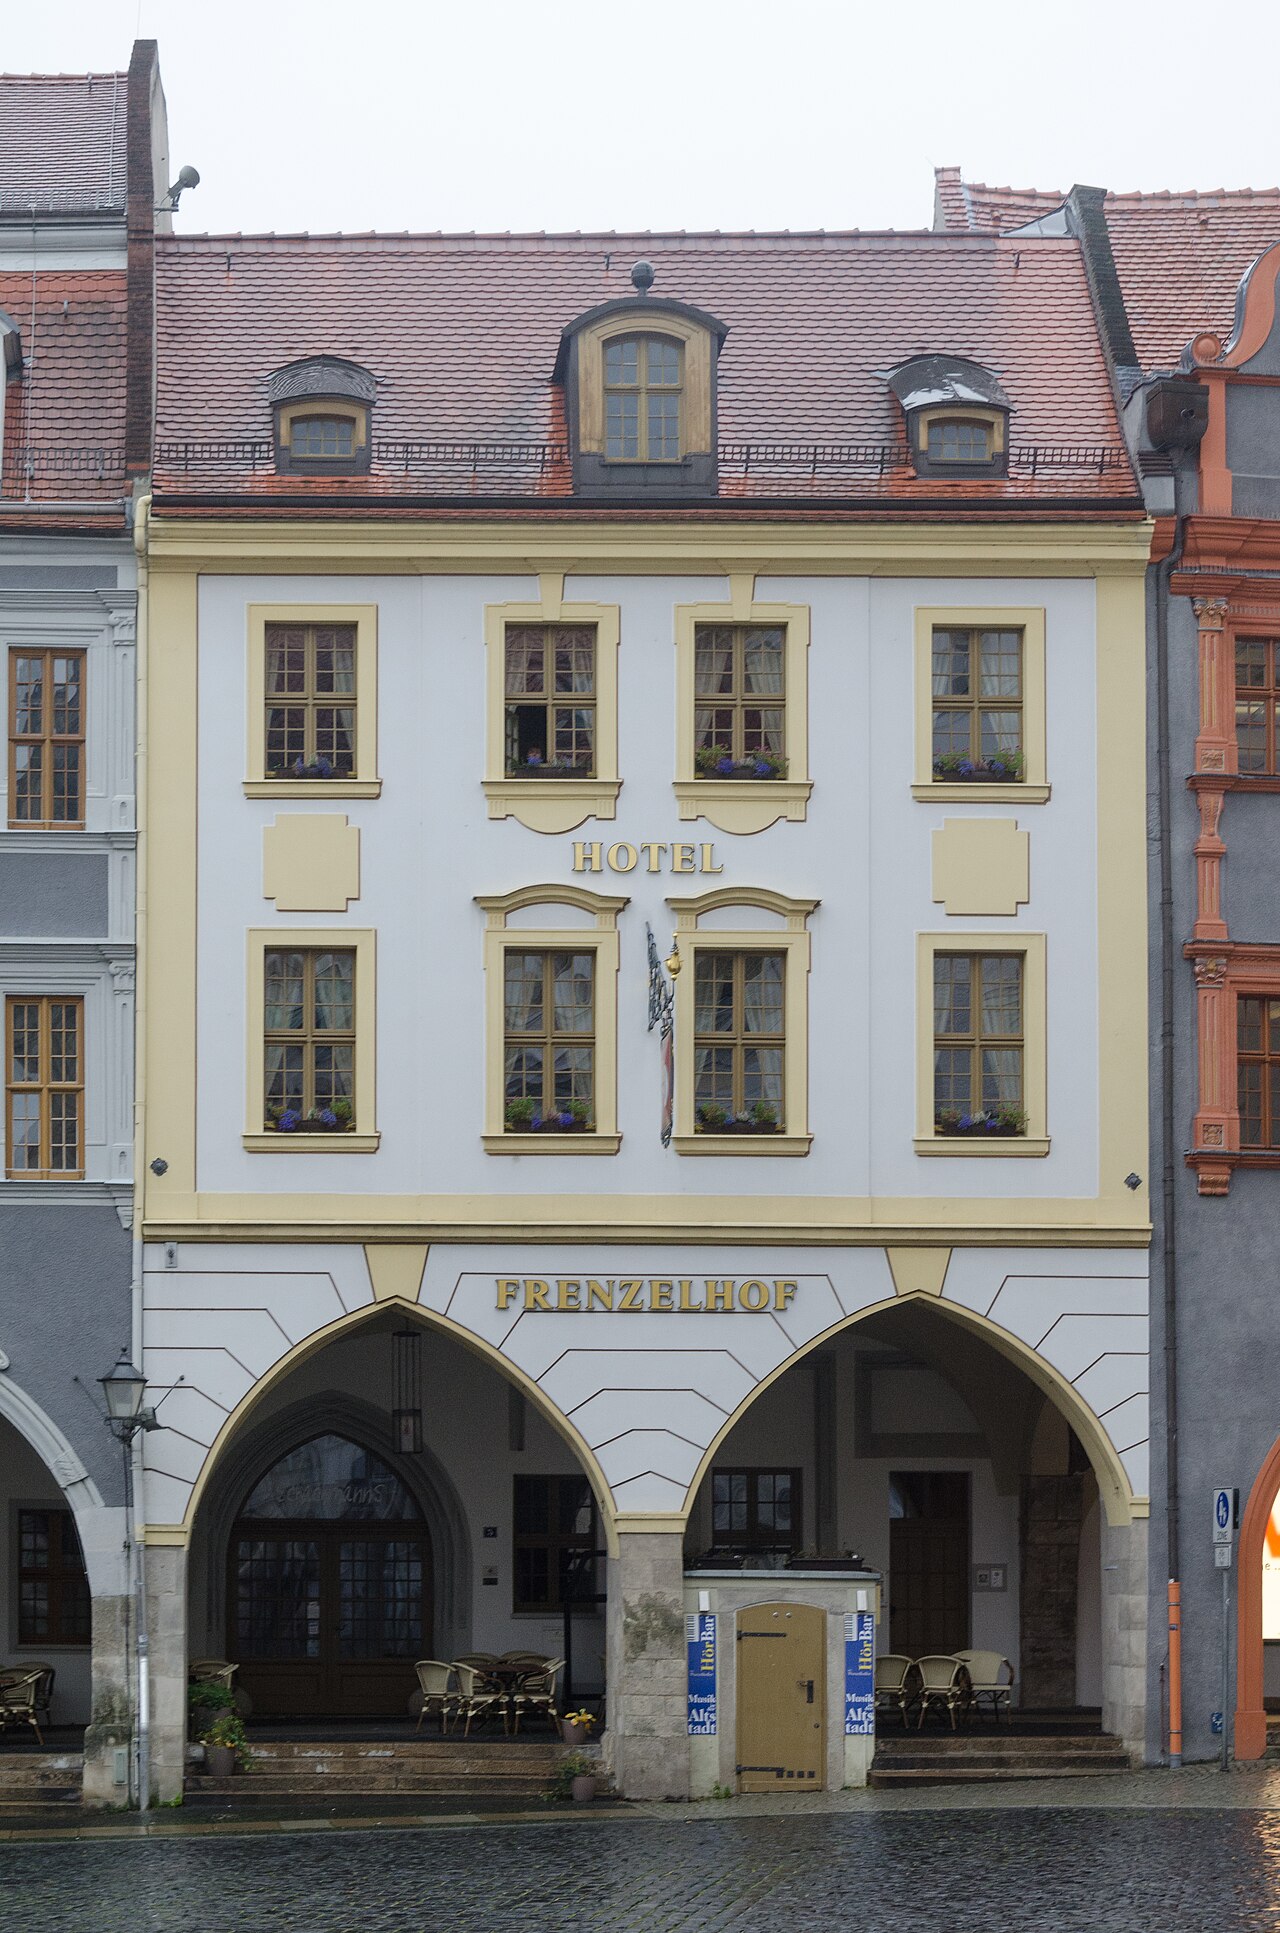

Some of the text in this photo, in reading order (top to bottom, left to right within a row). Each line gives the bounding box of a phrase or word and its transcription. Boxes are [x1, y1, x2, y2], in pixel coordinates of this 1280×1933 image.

[571, 842, 723, 873] HOTEL
[495, 1279, 798, 1311] FRENZELHOF
[700, 1615, 714, 1670] HörBar
[858, 1615, 873, 1670] HörBar
